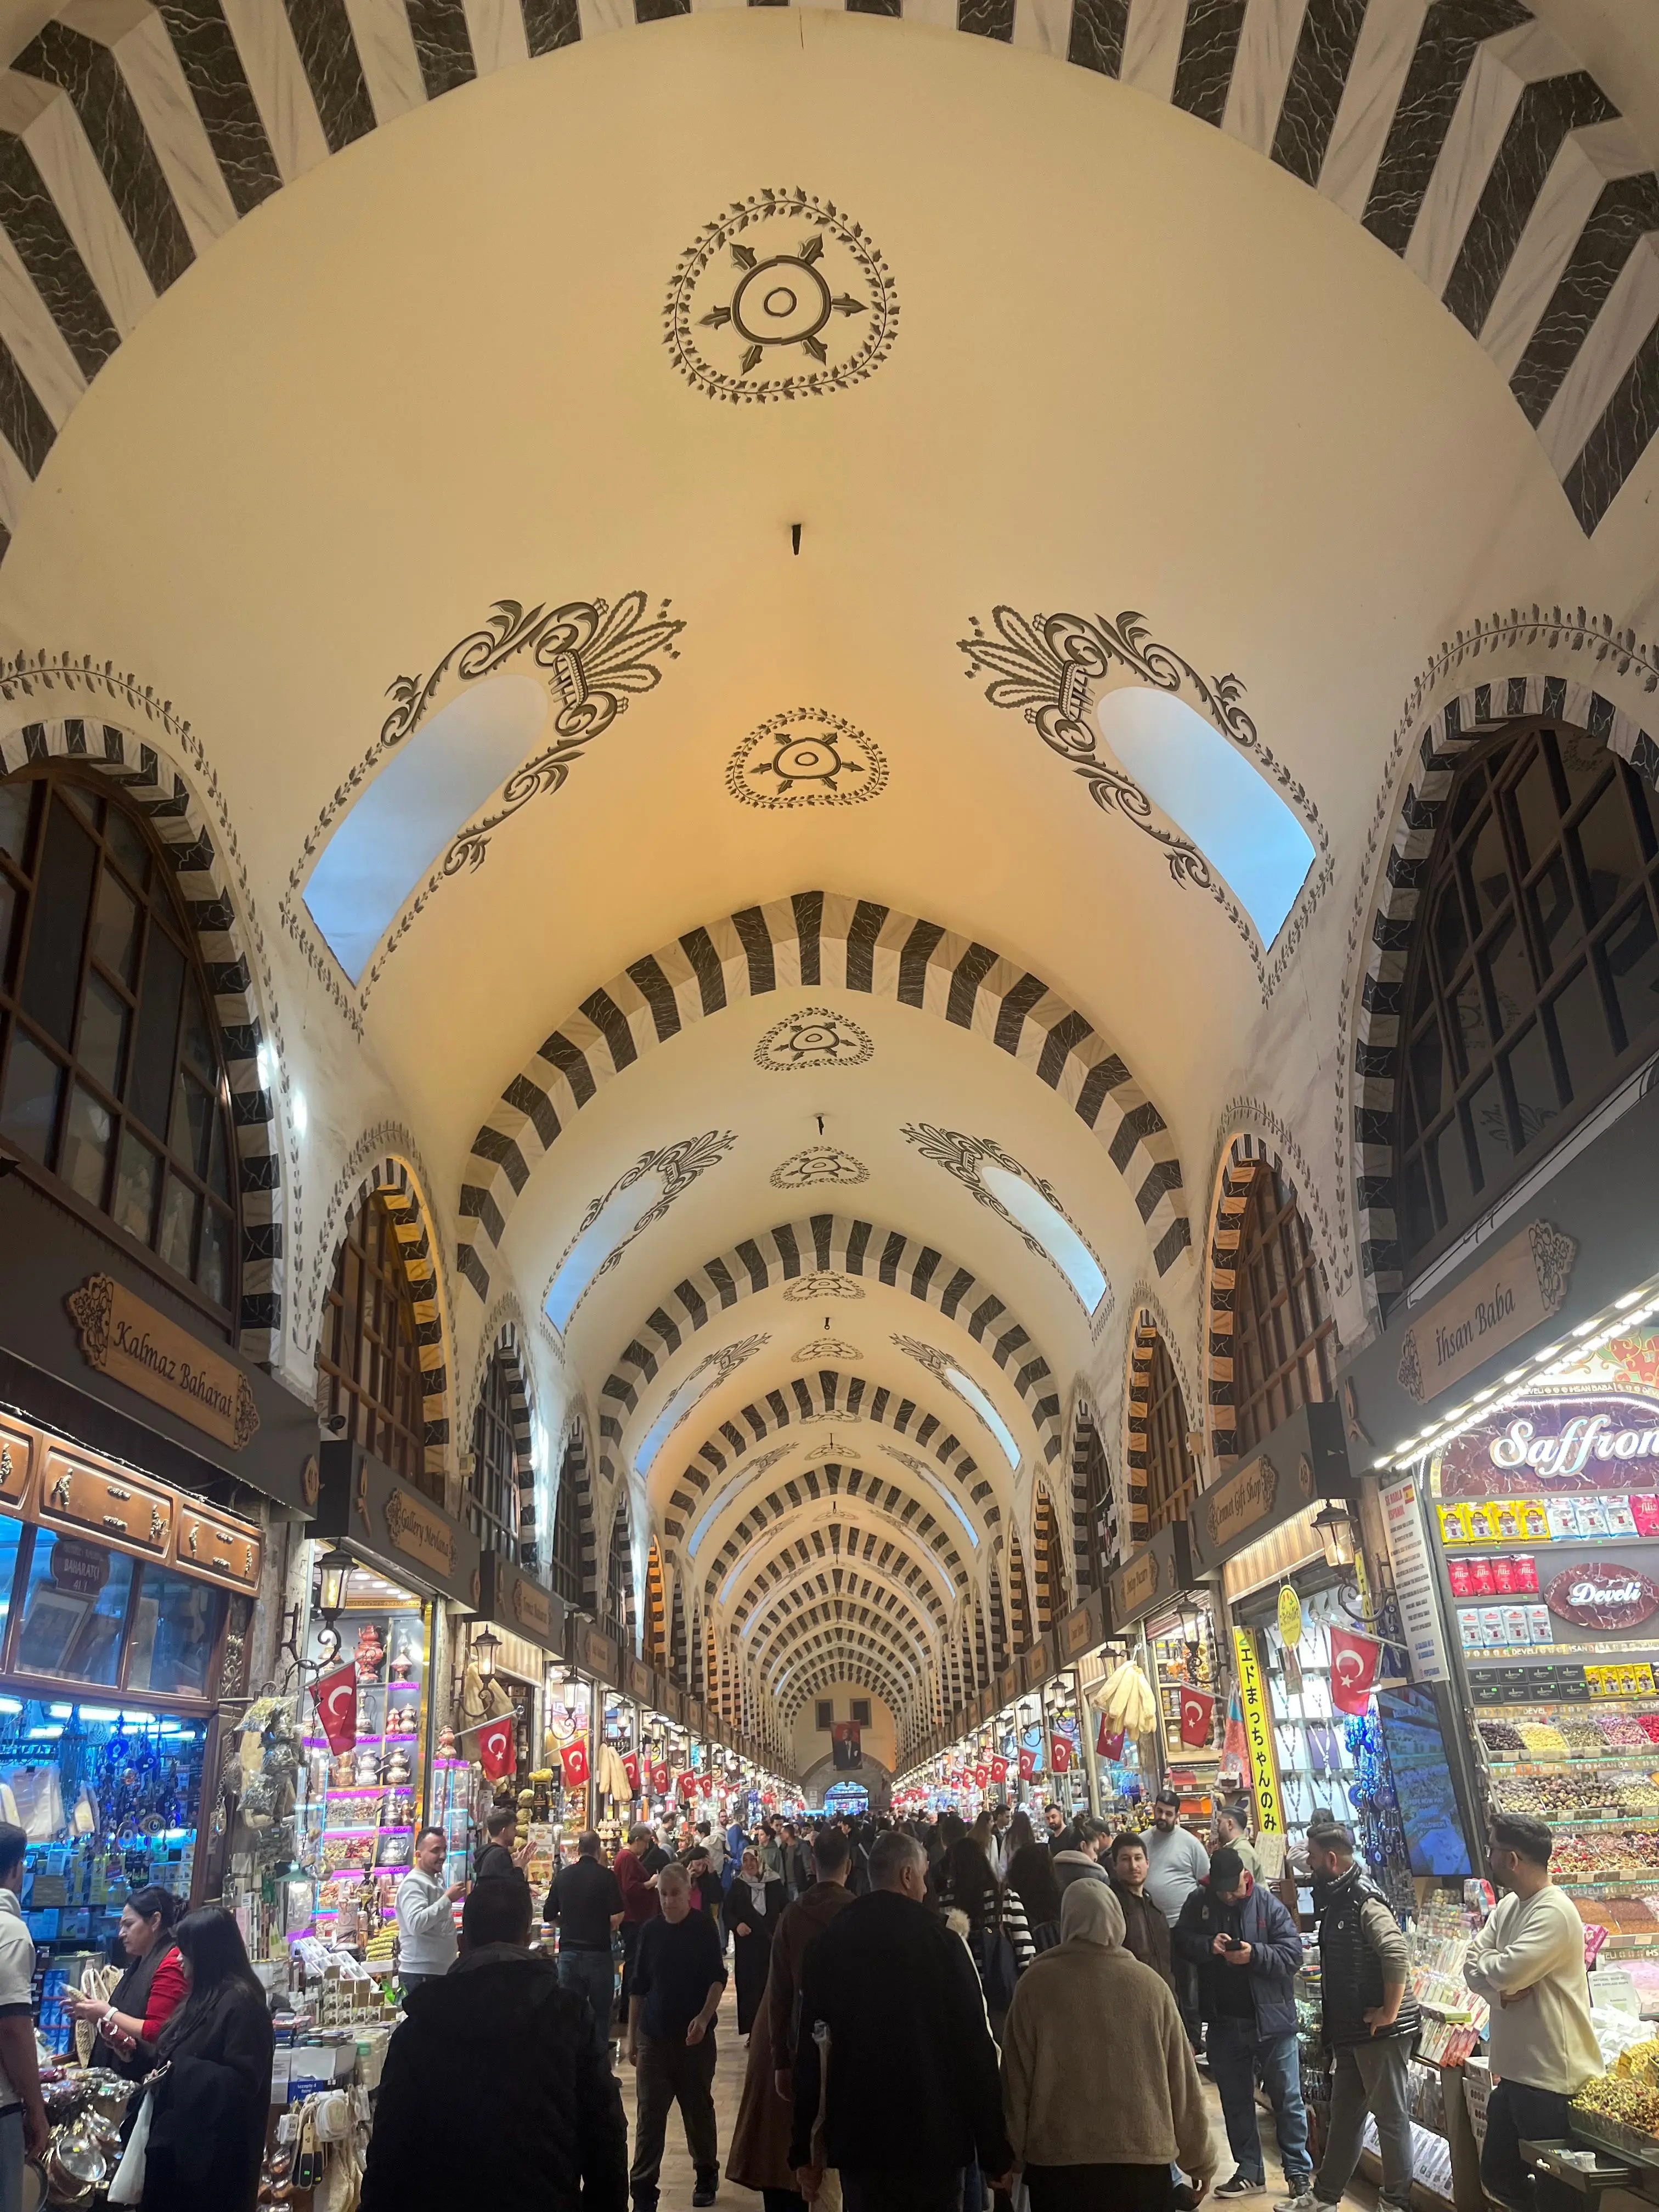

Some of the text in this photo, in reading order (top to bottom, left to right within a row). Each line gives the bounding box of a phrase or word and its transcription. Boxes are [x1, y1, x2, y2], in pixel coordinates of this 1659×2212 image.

[1436, 1282, 1516, 1367] İhsan Baba
[112, 1321, 233, 1419] Kalmaz Baharat
[1300, 1464, 1309, 1485] 48
[1216, 1477, 1262, 1526] Cennet Gift Shop
[401, 1508, 450, 1557] Gallery Mevlana
[64, 1558, 100, 1582] BAHARATÇI
[1570, 1582, 1641, 1603] Develi
